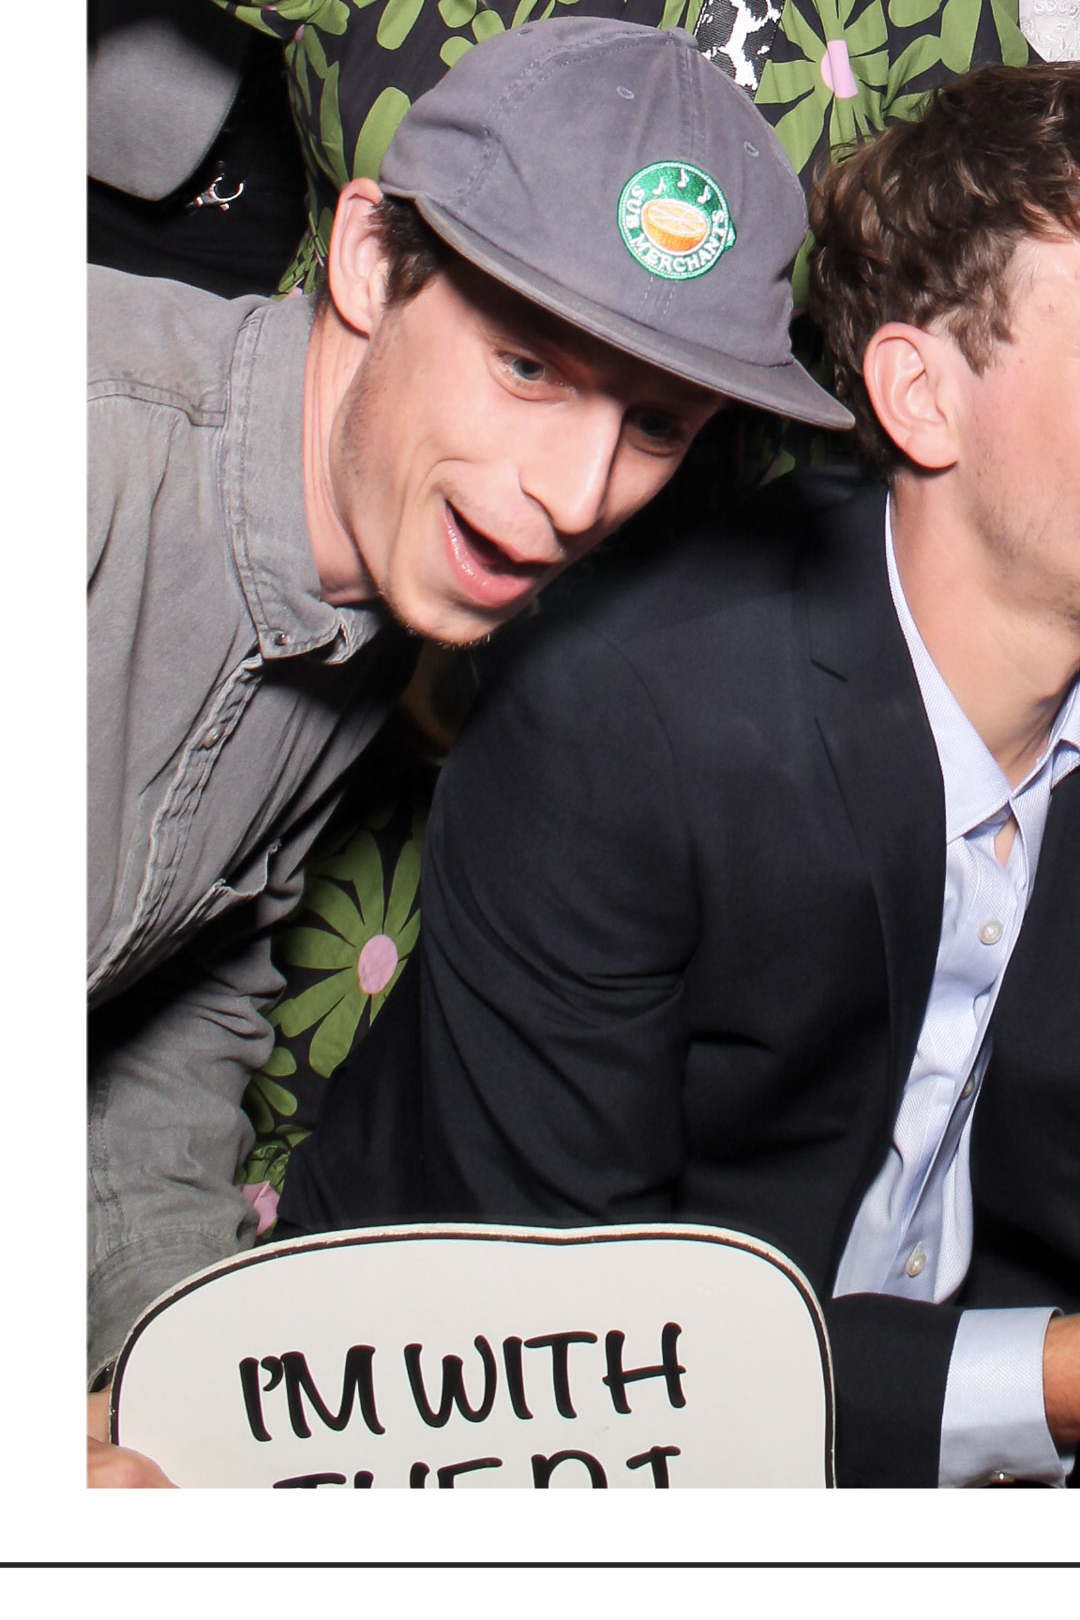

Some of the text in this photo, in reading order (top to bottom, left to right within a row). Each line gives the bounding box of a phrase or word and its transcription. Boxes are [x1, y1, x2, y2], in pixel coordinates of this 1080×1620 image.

[625, 185, 726, 273] SUB MERCHANTS
[238, 1322, 687, 1442] I'M WITH
